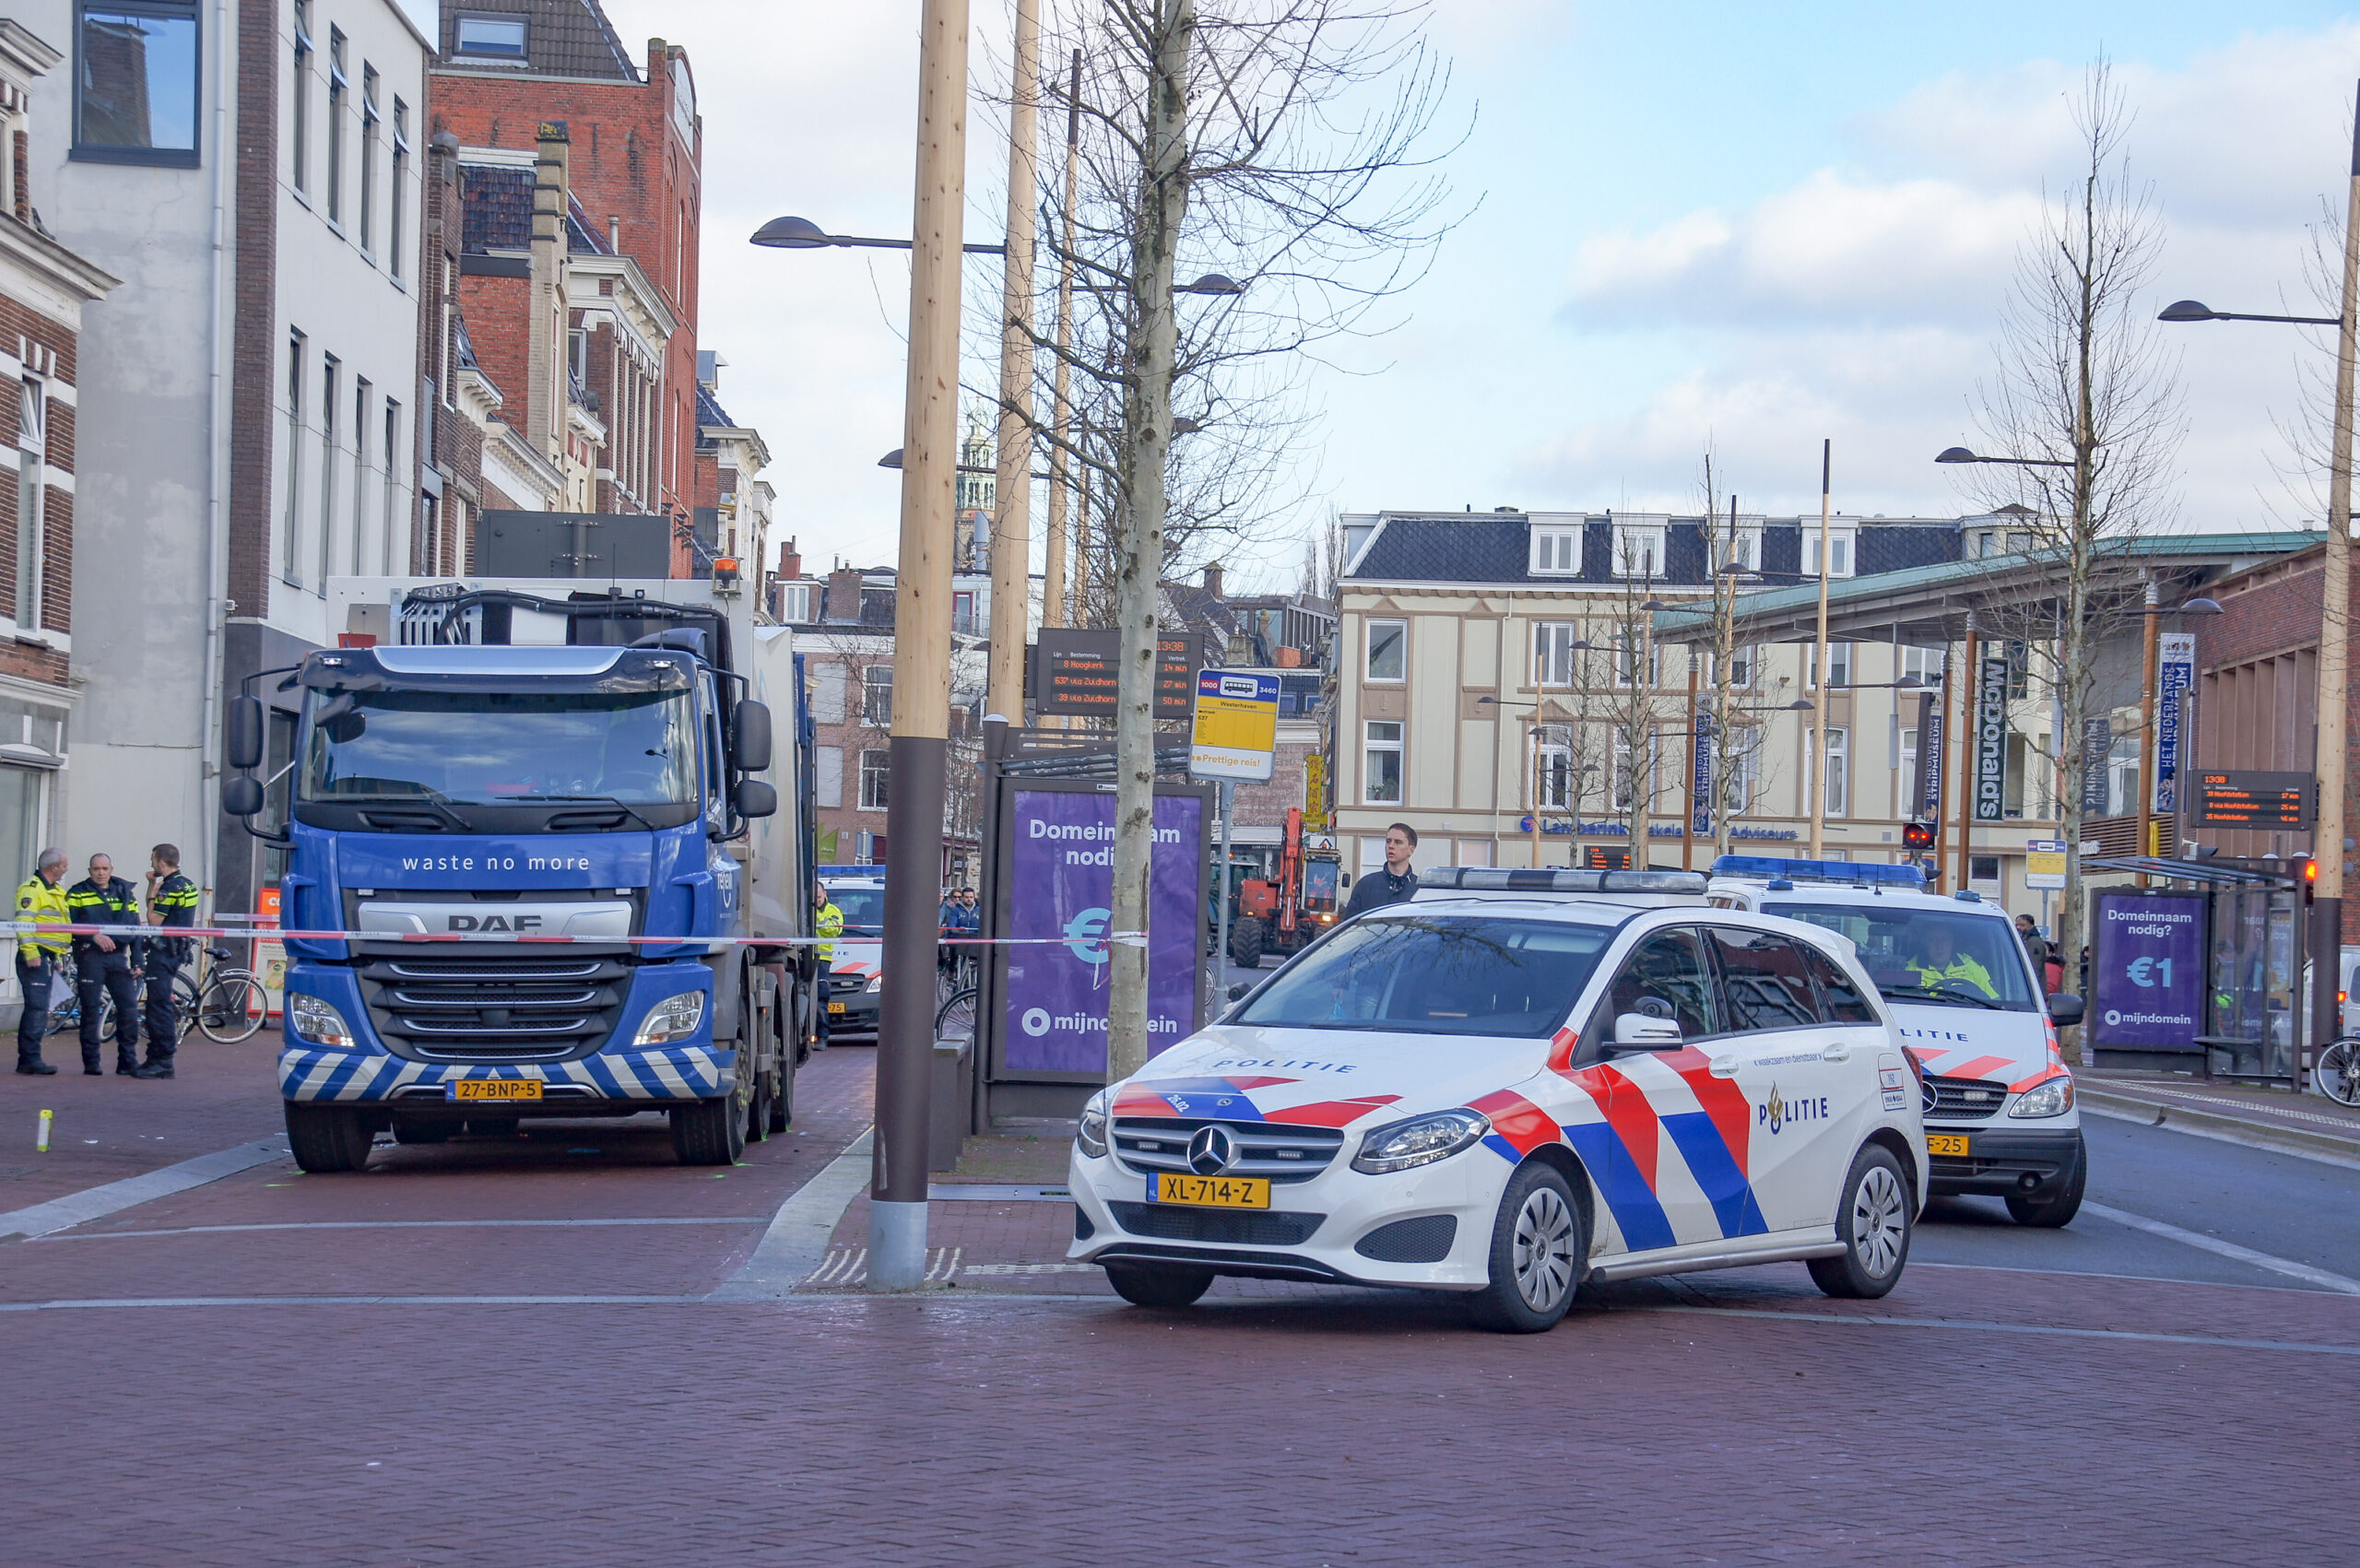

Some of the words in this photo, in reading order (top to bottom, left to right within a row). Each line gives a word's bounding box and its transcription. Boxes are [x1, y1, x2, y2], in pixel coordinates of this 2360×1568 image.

[1157, 641, 1185, 652] 13:38
[1069, 652, 1101, 660] Bestemming
[1070, 661, 1104, 670] Hoogkerk
[1164, 664, 1173, 672] 14
[1055, 677, 1068, 685] 637
[1070, 678, 1082, 686] via
[1083, 678, 1117, 687] Zuidhorn
[1163, 680, 1173, 689] 27
[1258, 686, 1278, 695] 3460
[1083, 694, 1117, 703] Zuidhorn
[1162, 697, 1173, 705] 50
[1174, 698, 1186, 706] min
[1221, 701, 1257, 710] Westerhaven
[2163, 666, 2175, 743] NEDERLANDS
[1978, 662, 2005, 819] McDonald's
[1202, 754, 1239, 767] Prettige
[1240, 758, 1262, 768] reis!
[1930, 719, 1941, 800] STRIPMUSEUM
[2161, 746, 2171, 768] HET
[1729, 825, 1799, 840] Adviseurs
[402, 855, 474, 871] waste
[487, 857, 514, 871] no
[528, 857, 590, 871] more
[2107, 909, 2192, 923] Domeinnaam
[448, 915, 542, 932] DAF
[2128, 925, 2172, 938] nodig?
[2126, 956, 2173, 988] €1
[2122, 1012, 2191, 1026] mijndomein
[1899, 1028, 1969, 1042] LITIE
[1213, 1059, 1358, 1074] POLITIE
[461, 1082, 537, 1097] 27-BNP-5
[1166, 1094, 1190, 1113] 26.02
[1759, 1097, 1829, 1135] POLITIE
[1166, 1177, 1254, 1203] XL-714-Z
